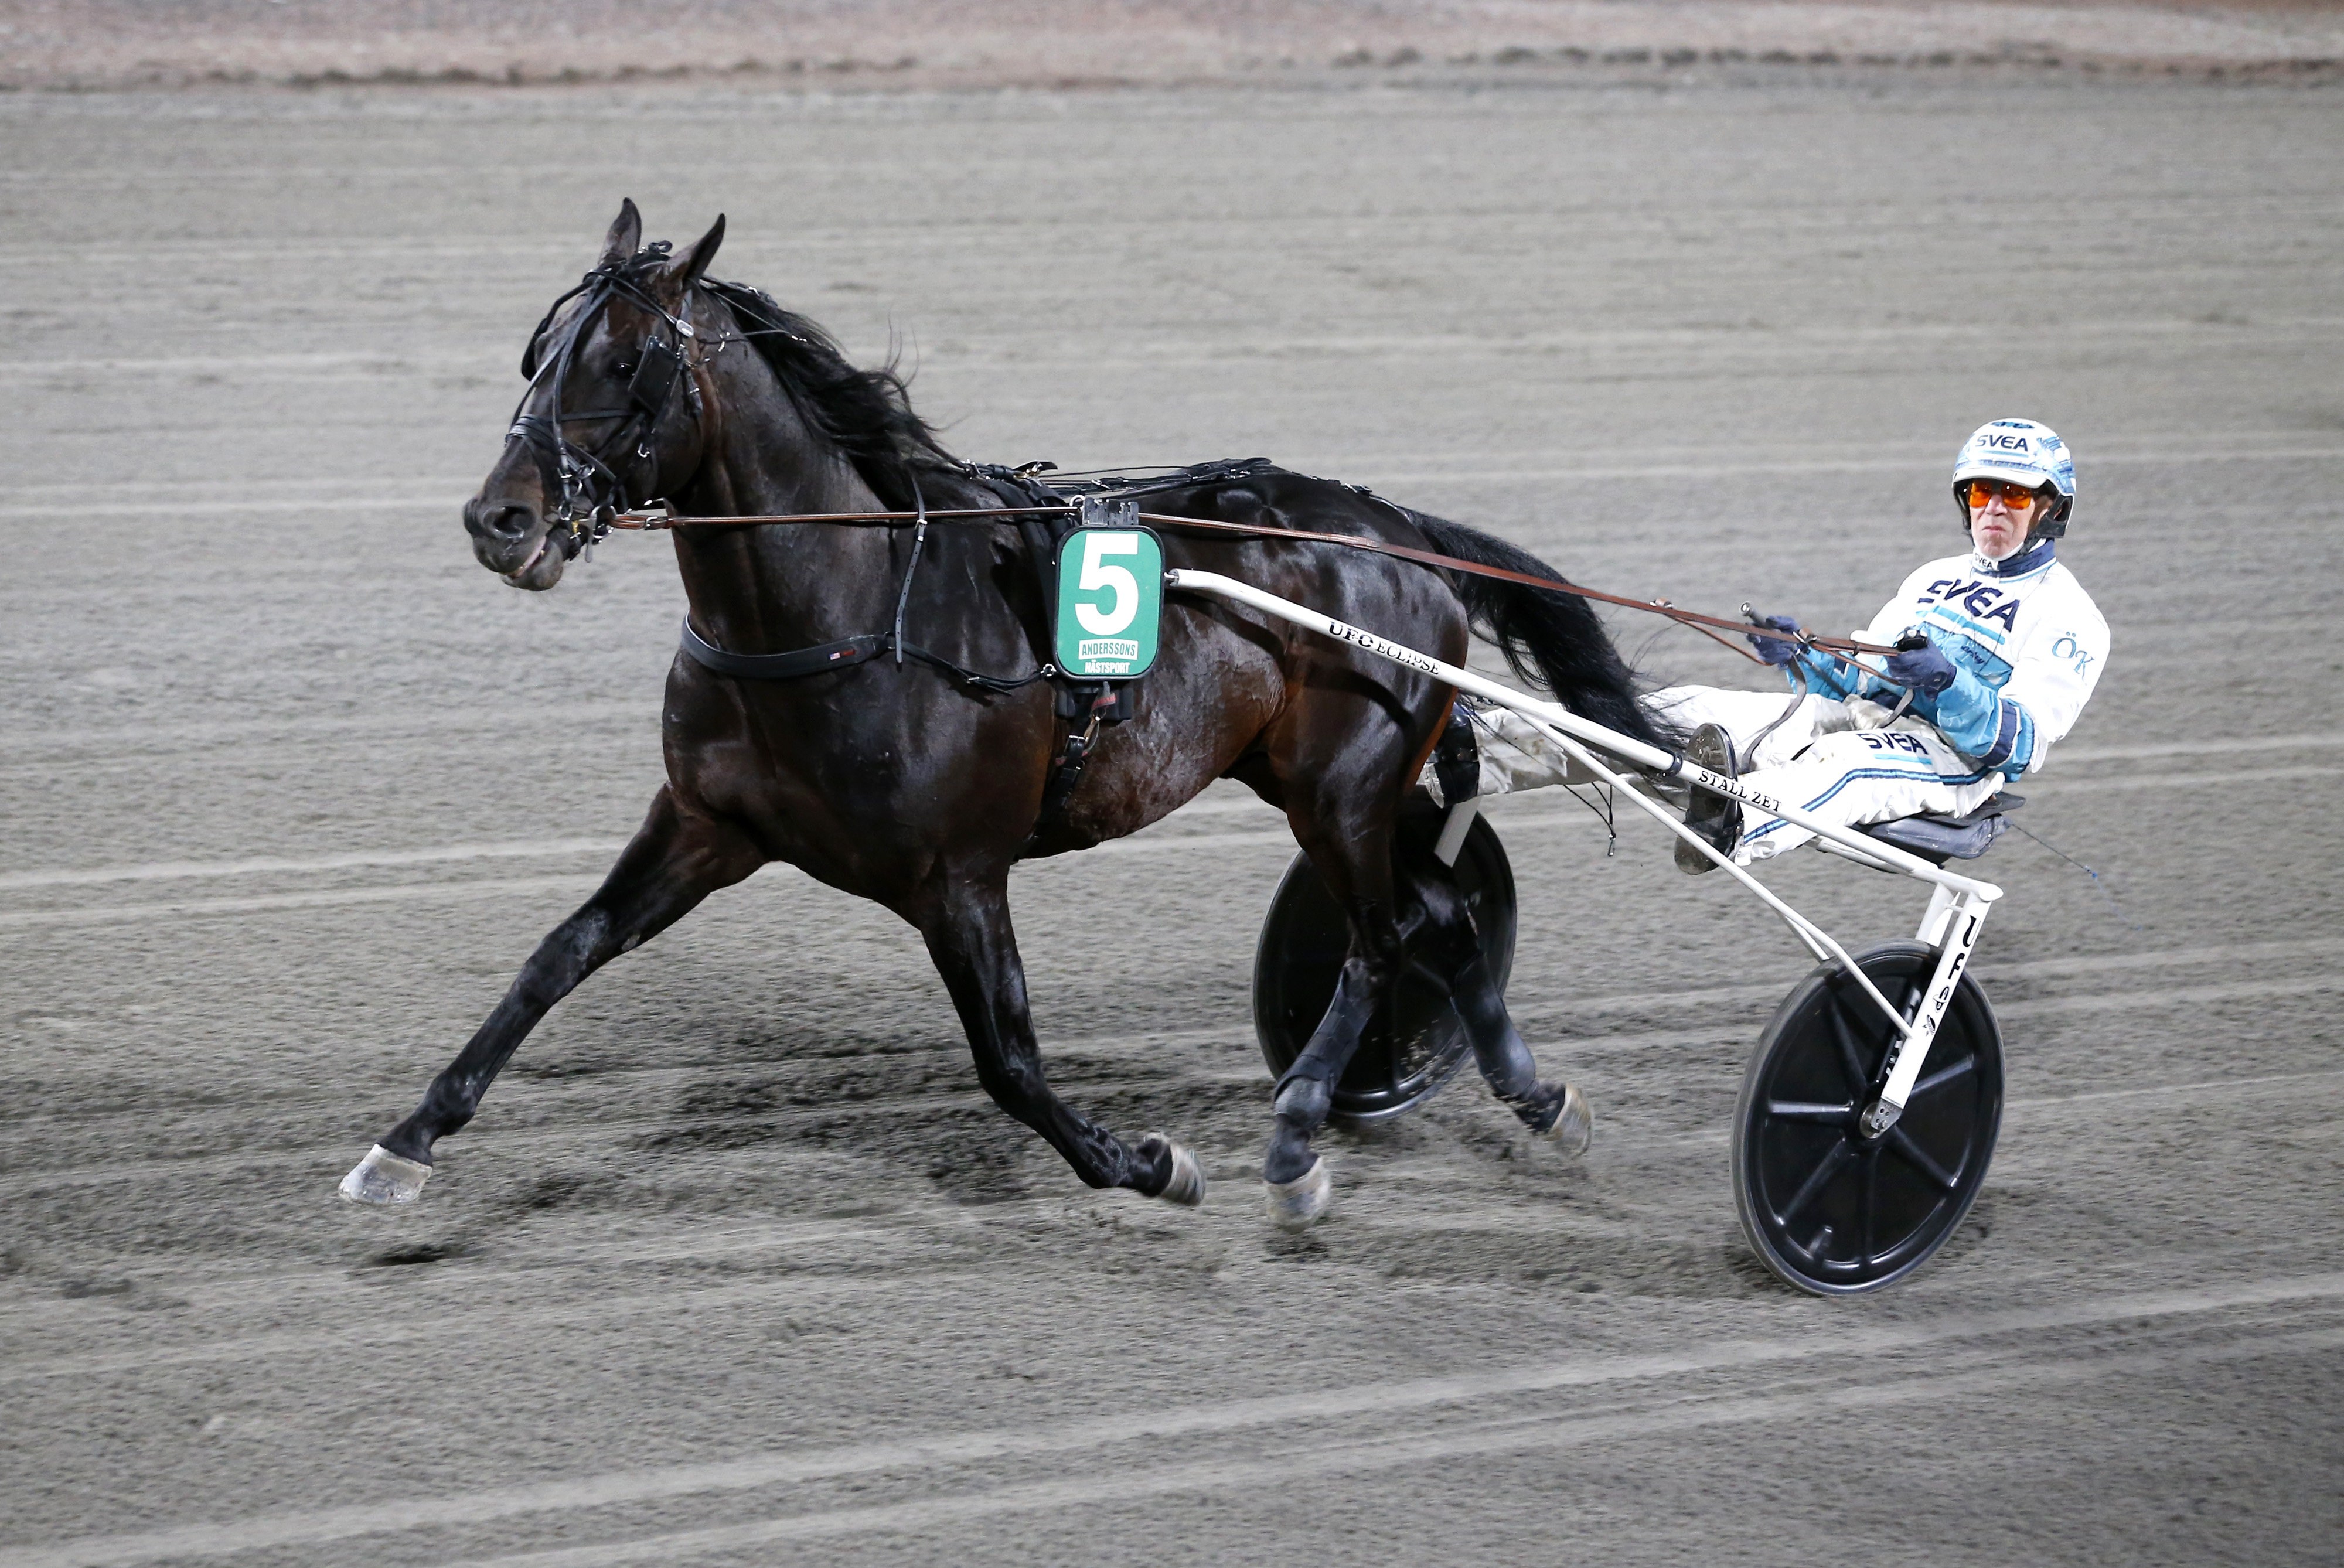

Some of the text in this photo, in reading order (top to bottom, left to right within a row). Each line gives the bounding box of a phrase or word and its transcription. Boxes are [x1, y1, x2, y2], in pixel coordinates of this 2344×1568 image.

[1975, 434, 2028, 452] SVEA
[1975, 553, 1993, 568] SVEA
[1074, 533, 1139, 636] 5
[1917, 578, 2021, 632] SVEA
[1081, 642, 1136, 656] ANDERSSONS
[1376, 641, 1441, 675] ECLIPSE
[1084, 659, 1130, 674] HÄSTSPORT
[1856, 732, 1929, 755] SVEA
[1698, 770, 1782, 812] STALL ZET
